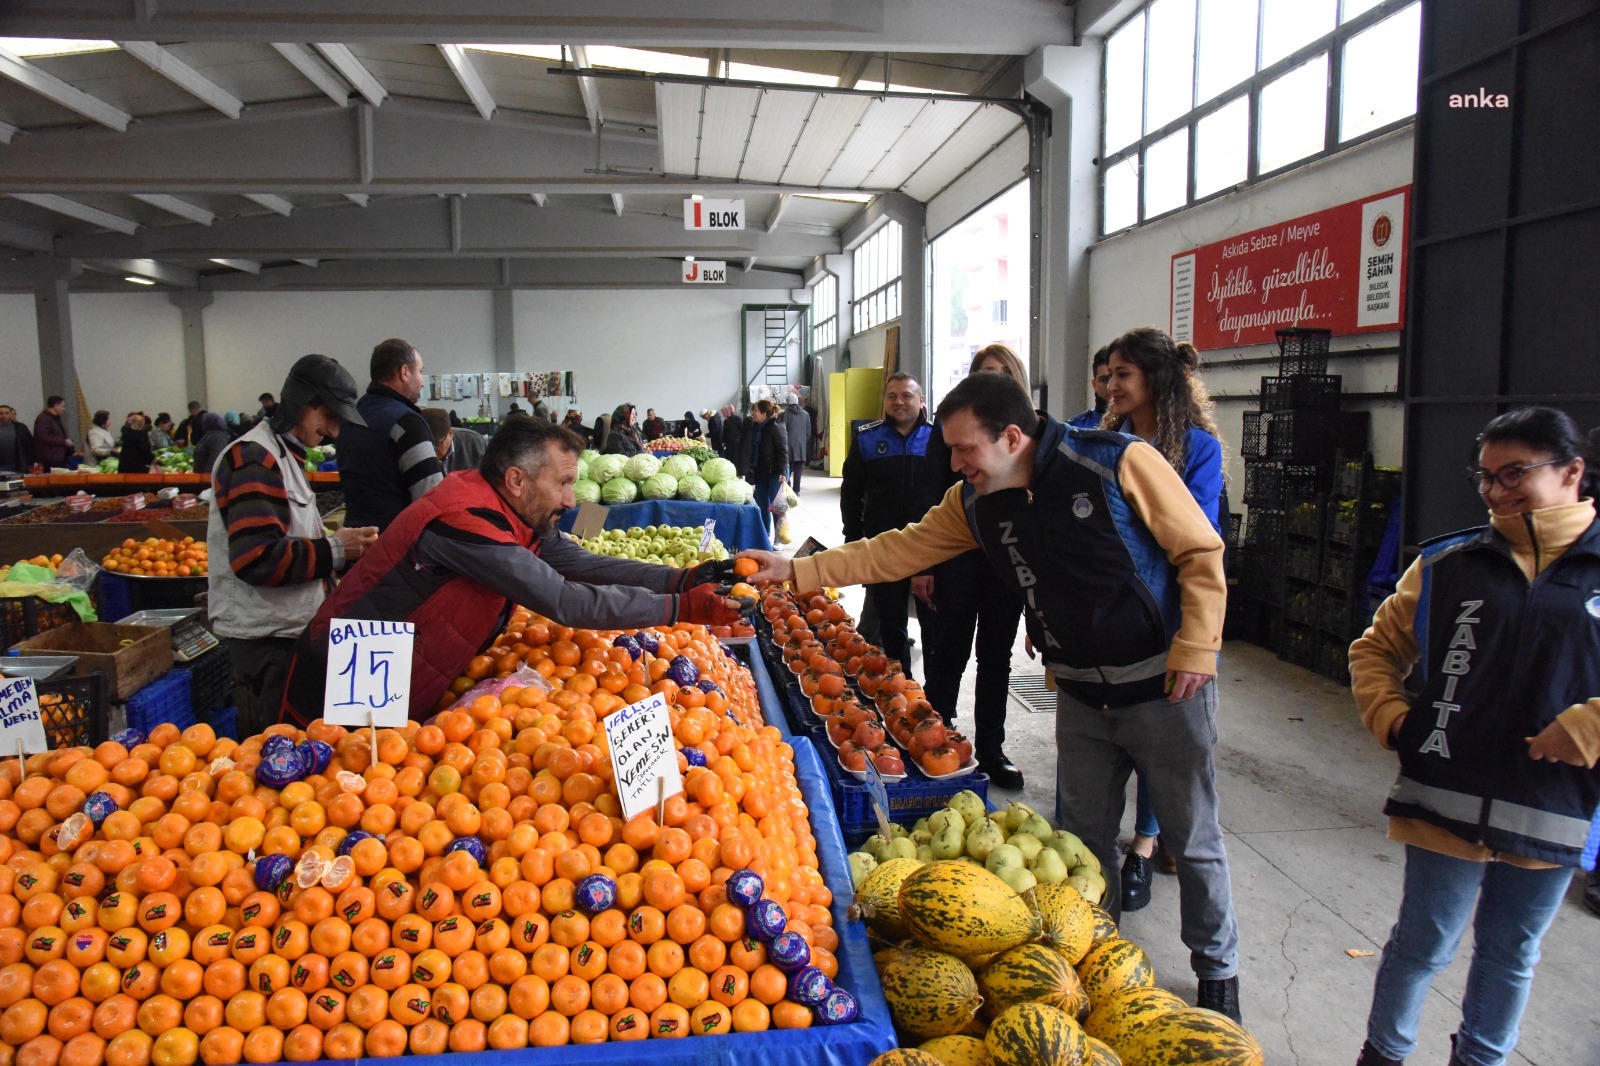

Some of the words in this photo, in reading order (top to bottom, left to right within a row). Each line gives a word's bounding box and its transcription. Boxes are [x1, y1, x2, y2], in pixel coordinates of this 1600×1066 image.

[693, 202, 702, 228] I
[709, 211, 739, 228] BLOK
[1250, 234, 1278, 252] Sebze
[1287, 222, 1320, 243] Meyve
[685, 262, 698, 281] J
[703, 269, 725, 281] BLOK
[1262, 246, 1340, 305] güzellikle,
[1366, 264, 1393, 280] ŞAHİN
[1367, 253, 1394, 268] SEMİH
[999, 520, 1062, 650] ZABITA
[333, 642, 394, 709] 15
[1418, 600, 1485, 760] ZABITA
[0, 691, 32, 719] LMA
[618, 729, 653, 766] OLAN
